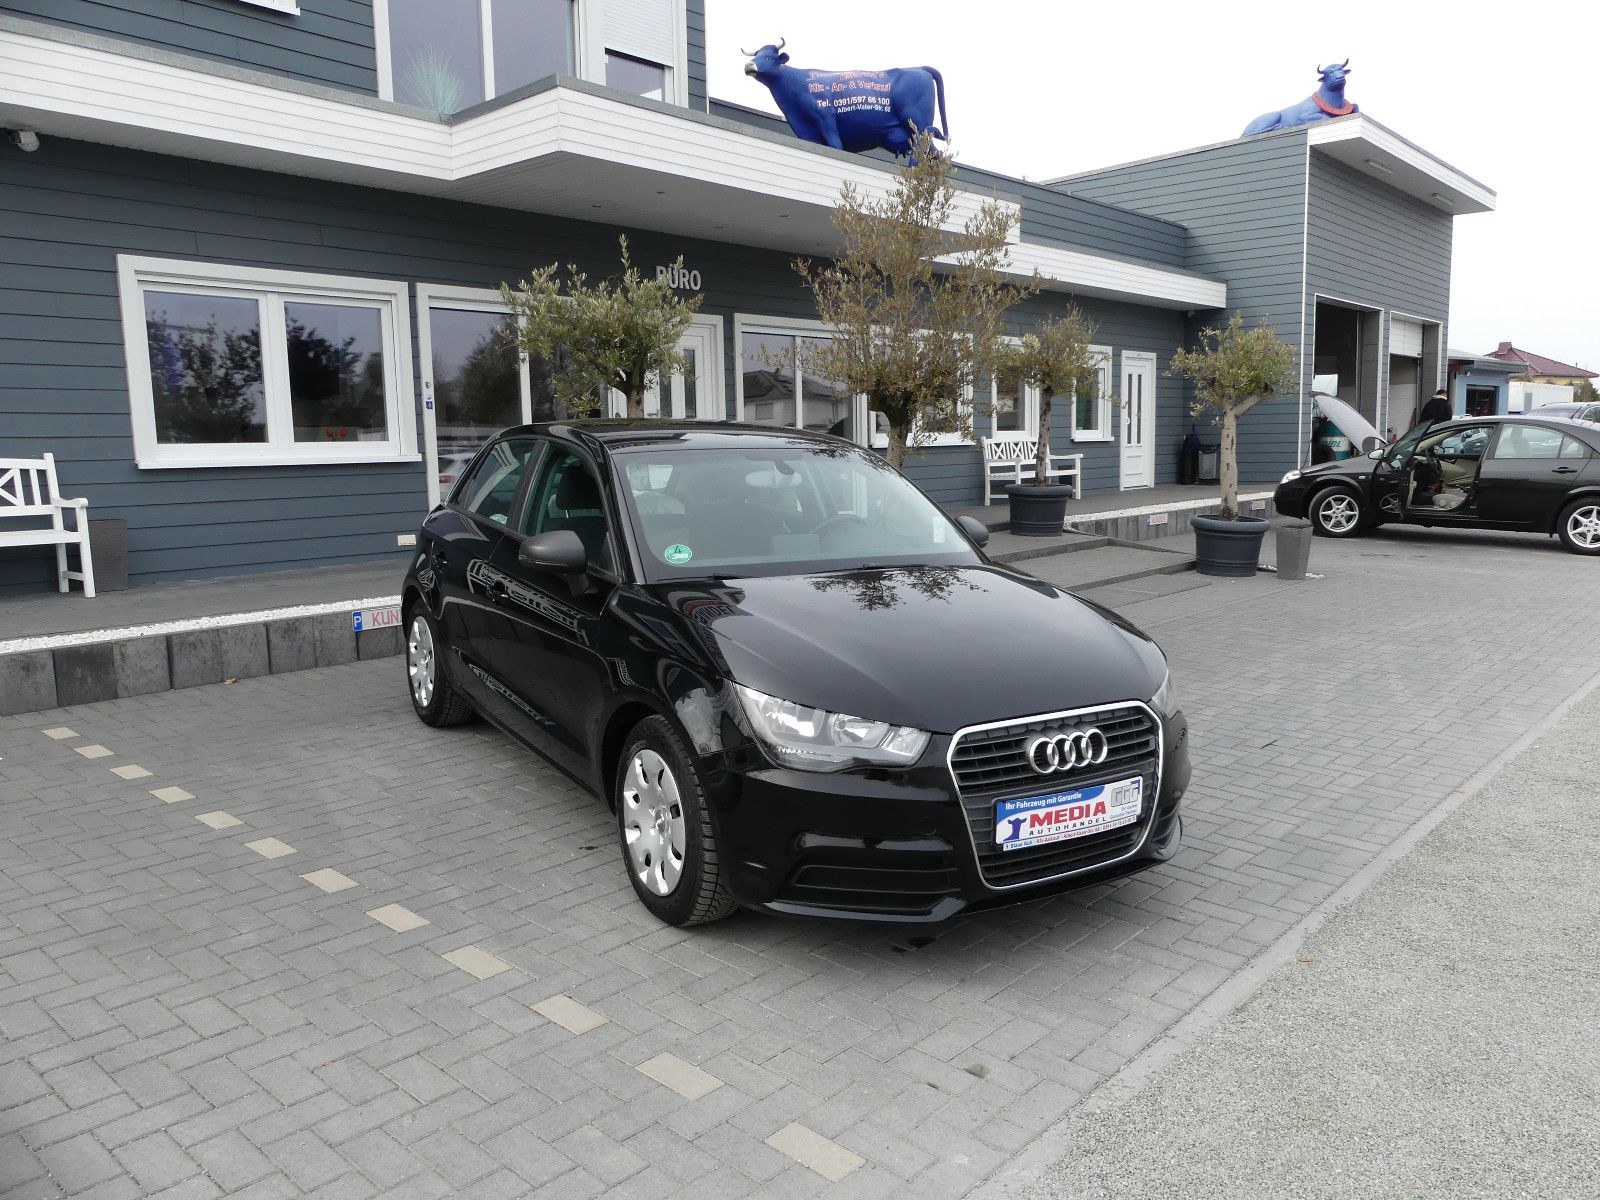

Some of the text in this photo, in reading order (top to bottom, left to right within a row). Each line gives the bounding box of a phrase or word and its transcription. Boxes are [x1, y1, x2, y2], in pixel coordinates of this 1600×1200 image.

[817, 99, 832, 107] Tel.
[833, 95, 867, 107] 0391/597
[878, 97, 890, 106] 100
[371, 610, 402, 627] KUN
[1005, 792, 1082, 811] Ihr Fahrzeug mit Garantie
[1029, 801, 1107, 829] MEDIA
[1029, 816, 1107, 836] AUTOHANDEL
